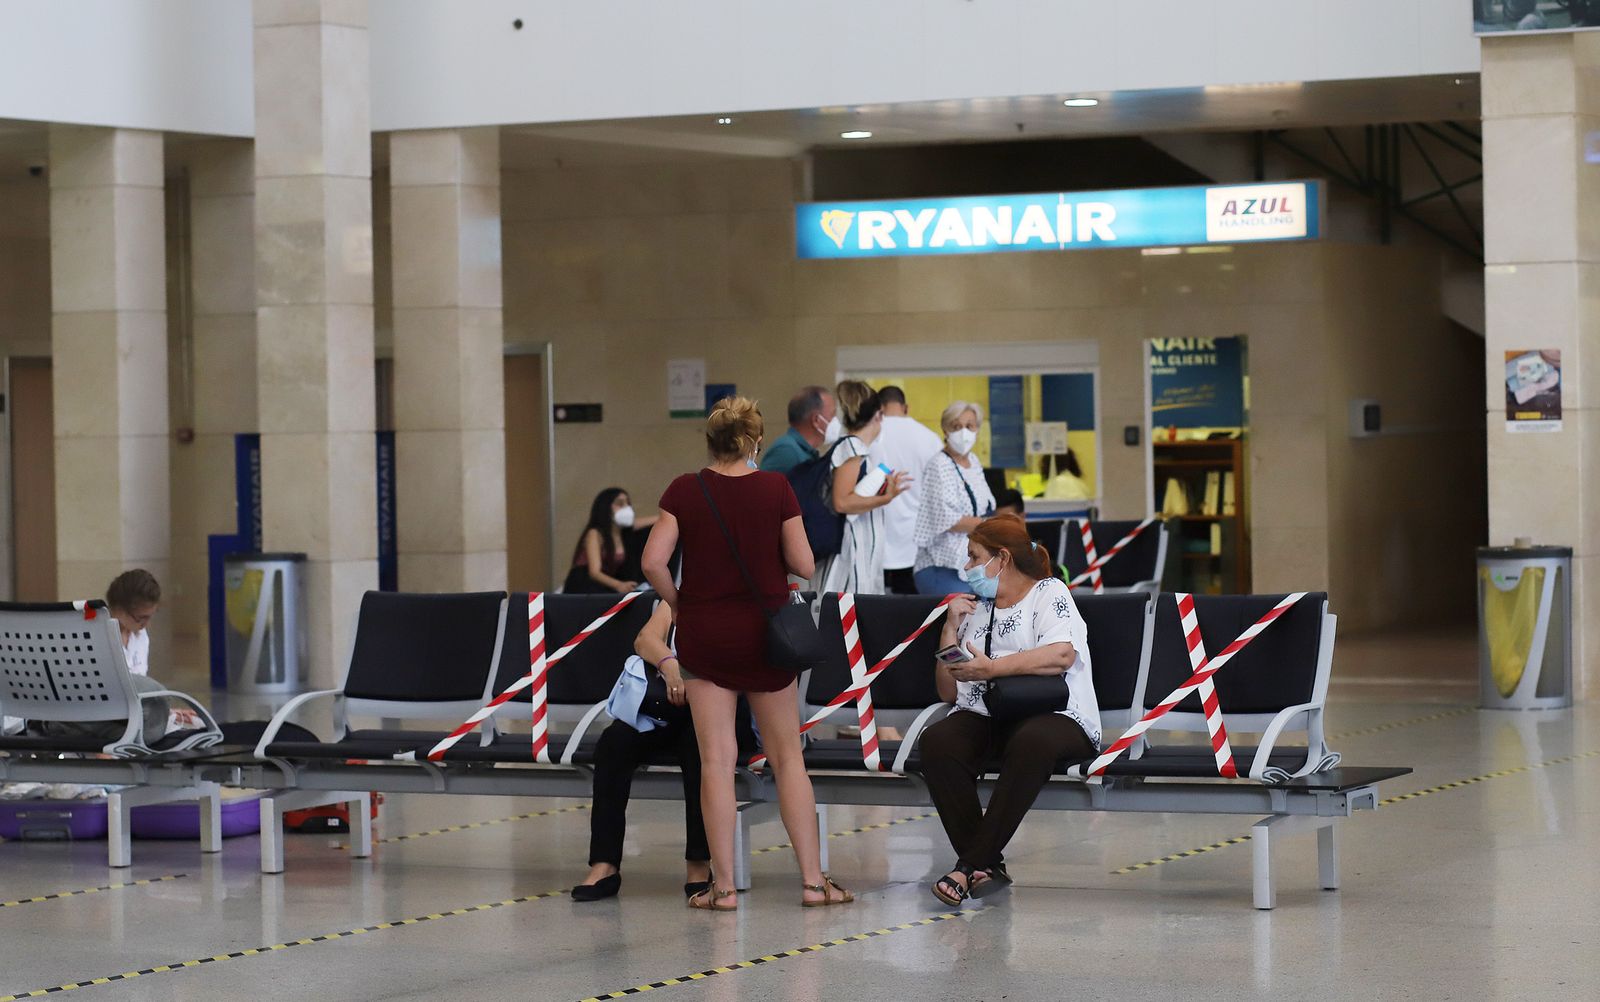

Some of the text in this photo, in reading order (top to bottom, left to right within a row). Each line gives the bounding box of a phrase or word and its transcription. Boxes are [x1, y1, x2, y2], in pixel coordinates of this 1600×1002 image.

[1221, 197, 1293, 216] AZUL
[858, 200, 1117, 250] RYANAIR
[1219, 215, 1294, 228] HANDLING
